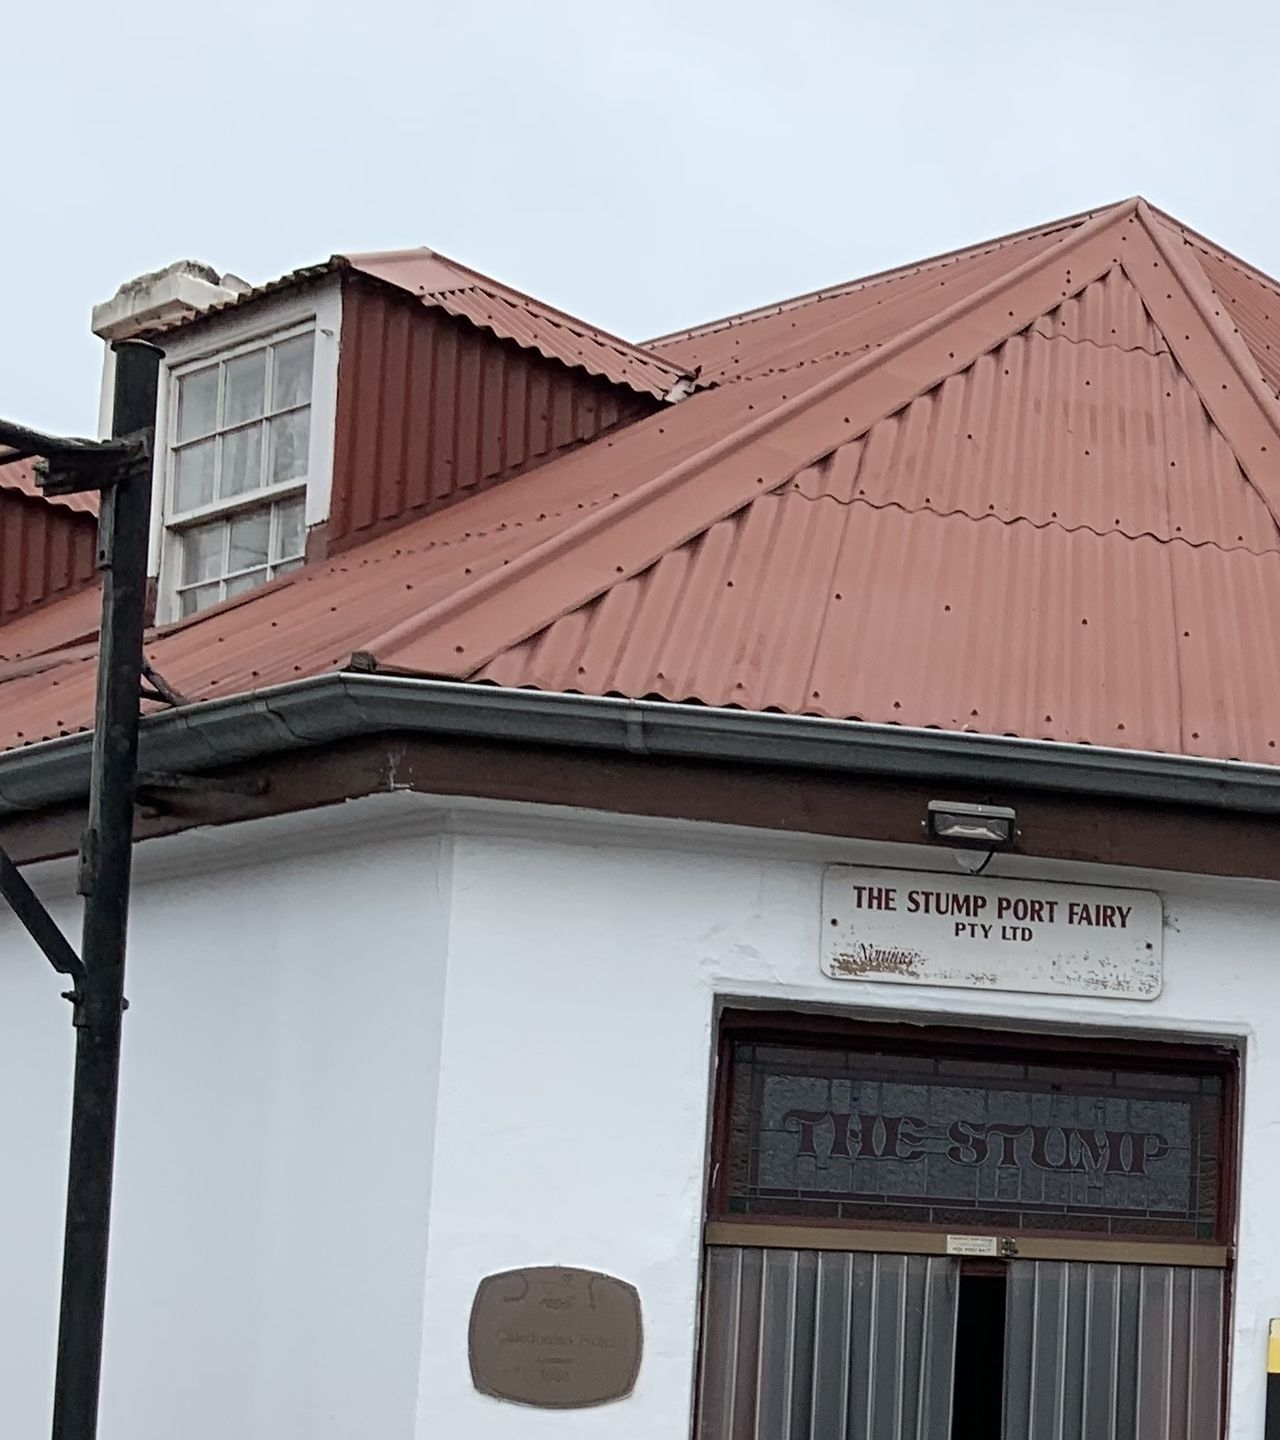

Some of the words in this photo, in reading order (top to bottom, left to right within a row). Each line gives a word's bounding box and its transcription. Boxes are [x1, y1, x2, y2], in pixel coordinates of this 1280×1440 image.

[853, 886, 896, 911] THE
[907, 890, 987, 917] STUMP
[997, 897, 1058, 923] PORT
[1068, 903, 1132, 928] FAIRY
[955, 922, 992, 938] PTY
[1001, 925, 1033, 942] LTD
[782, 1109, 929, 1162] THE
[946, 1121, 1171, 1175] STUMP
